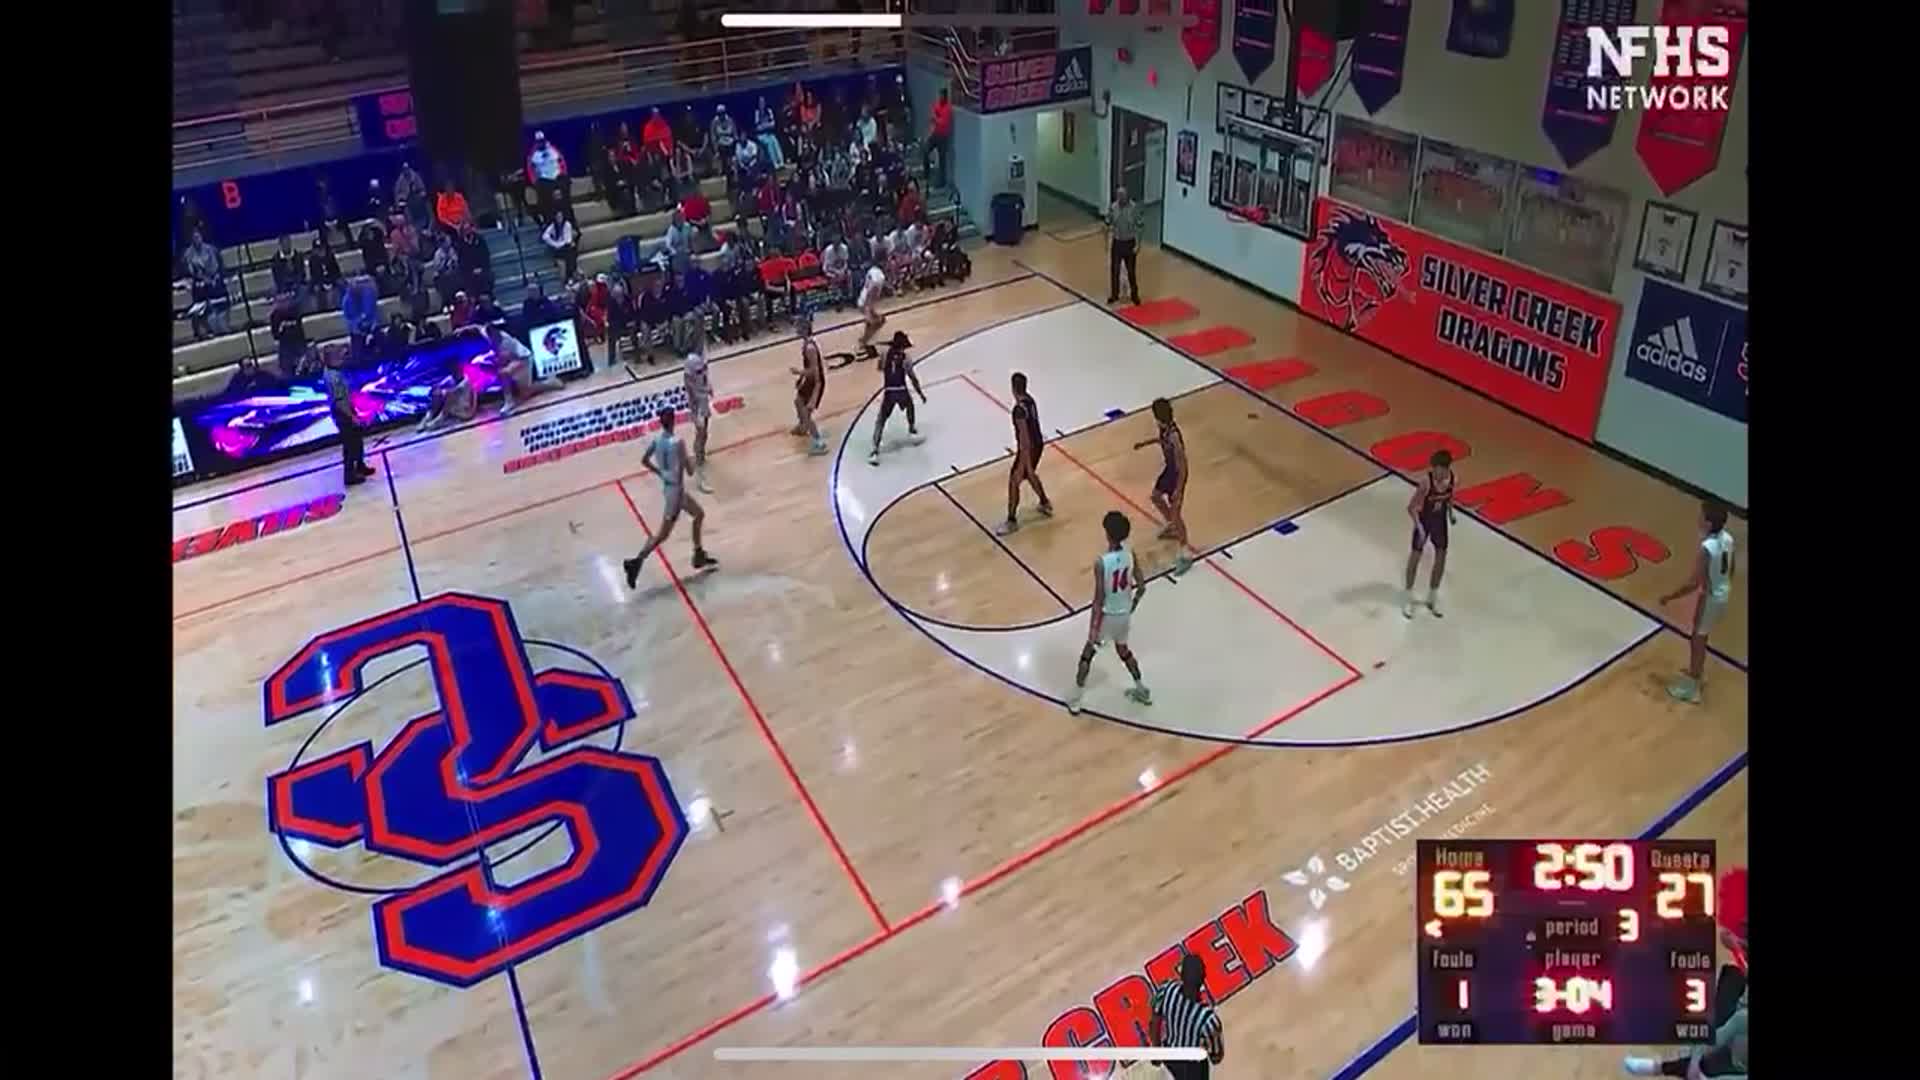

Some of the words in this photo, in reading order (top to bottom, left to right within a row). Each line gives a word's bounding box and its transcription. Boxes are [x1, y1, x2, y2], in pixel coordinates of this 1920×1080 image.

[1420, 254, 1507, 315] SILVER
[1510, 286, 1606, 354] CREEK
[1437, 307, 1569, 392] DRAGONS
[1636, 343, 1708, 383] adidas
[1335, 809, 1419, 871] BAPTIST
[1414, 762, 1492, 820] HEALTH
